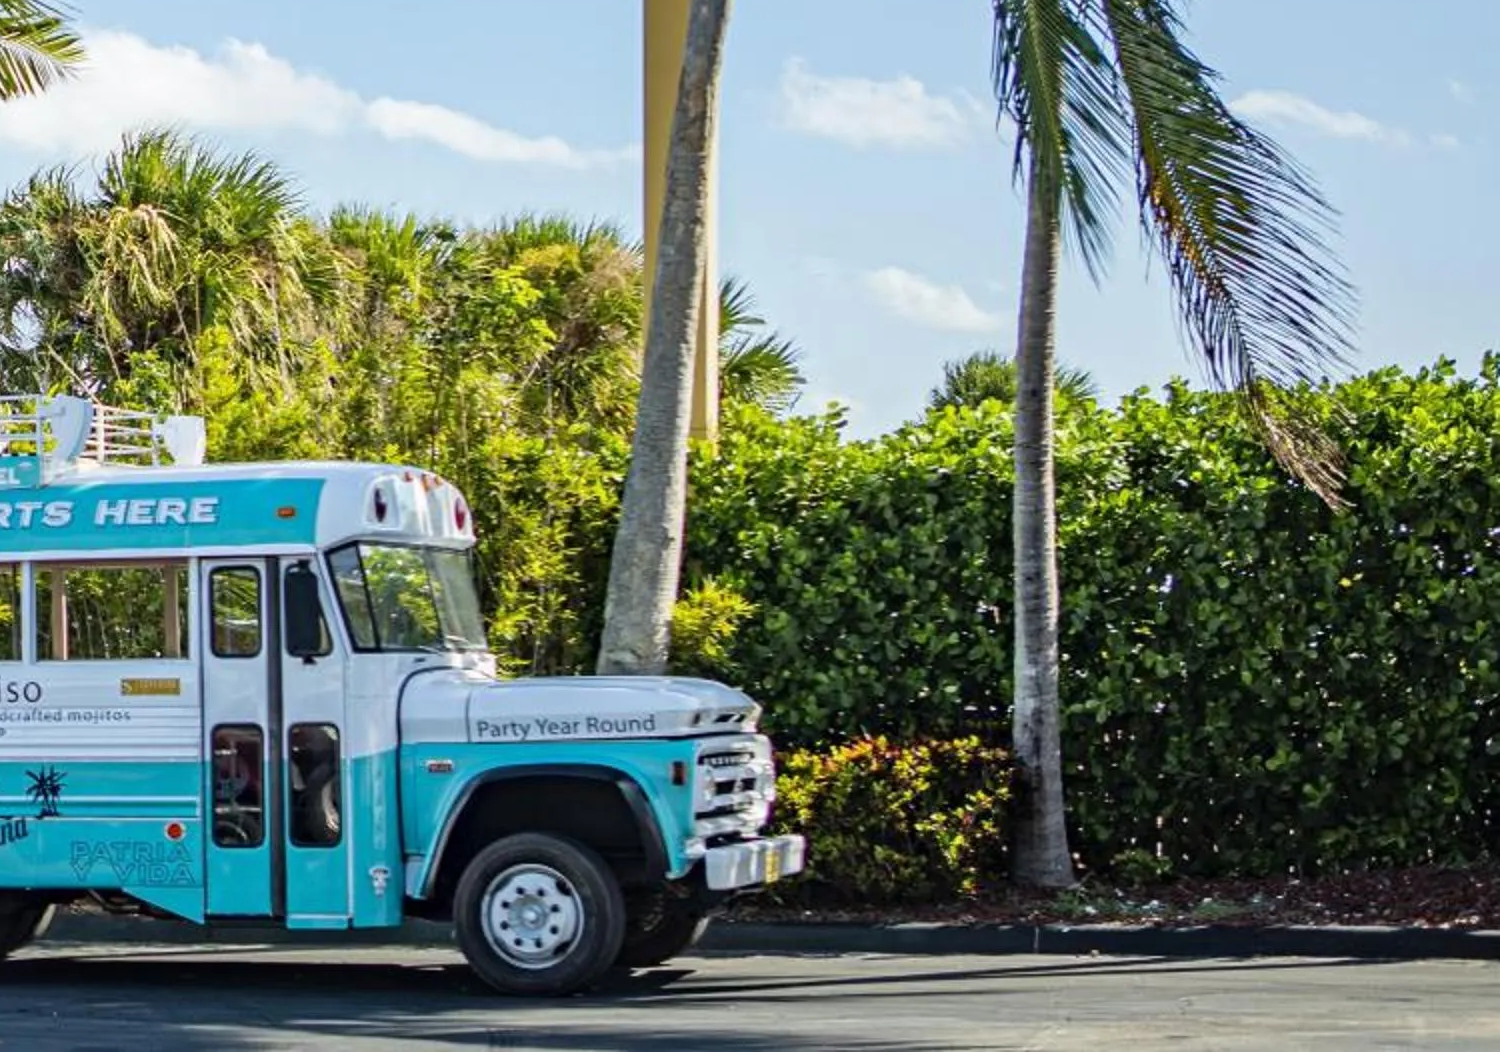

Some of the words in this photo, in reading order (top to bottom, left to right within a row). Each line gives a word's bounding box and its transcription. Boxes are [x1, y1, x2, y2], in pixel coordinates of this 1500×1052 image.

[94, 497, 220, 525] HERE
[67, 707, 131, 724] mojitos
[476, 720, 531, 742] Party
[535, 718, 580, 735] Year
[586, 714, 656, 733] Round
[70, 840, 193, 863] PATRIA
[111, 862, 197, 885] VIDA
